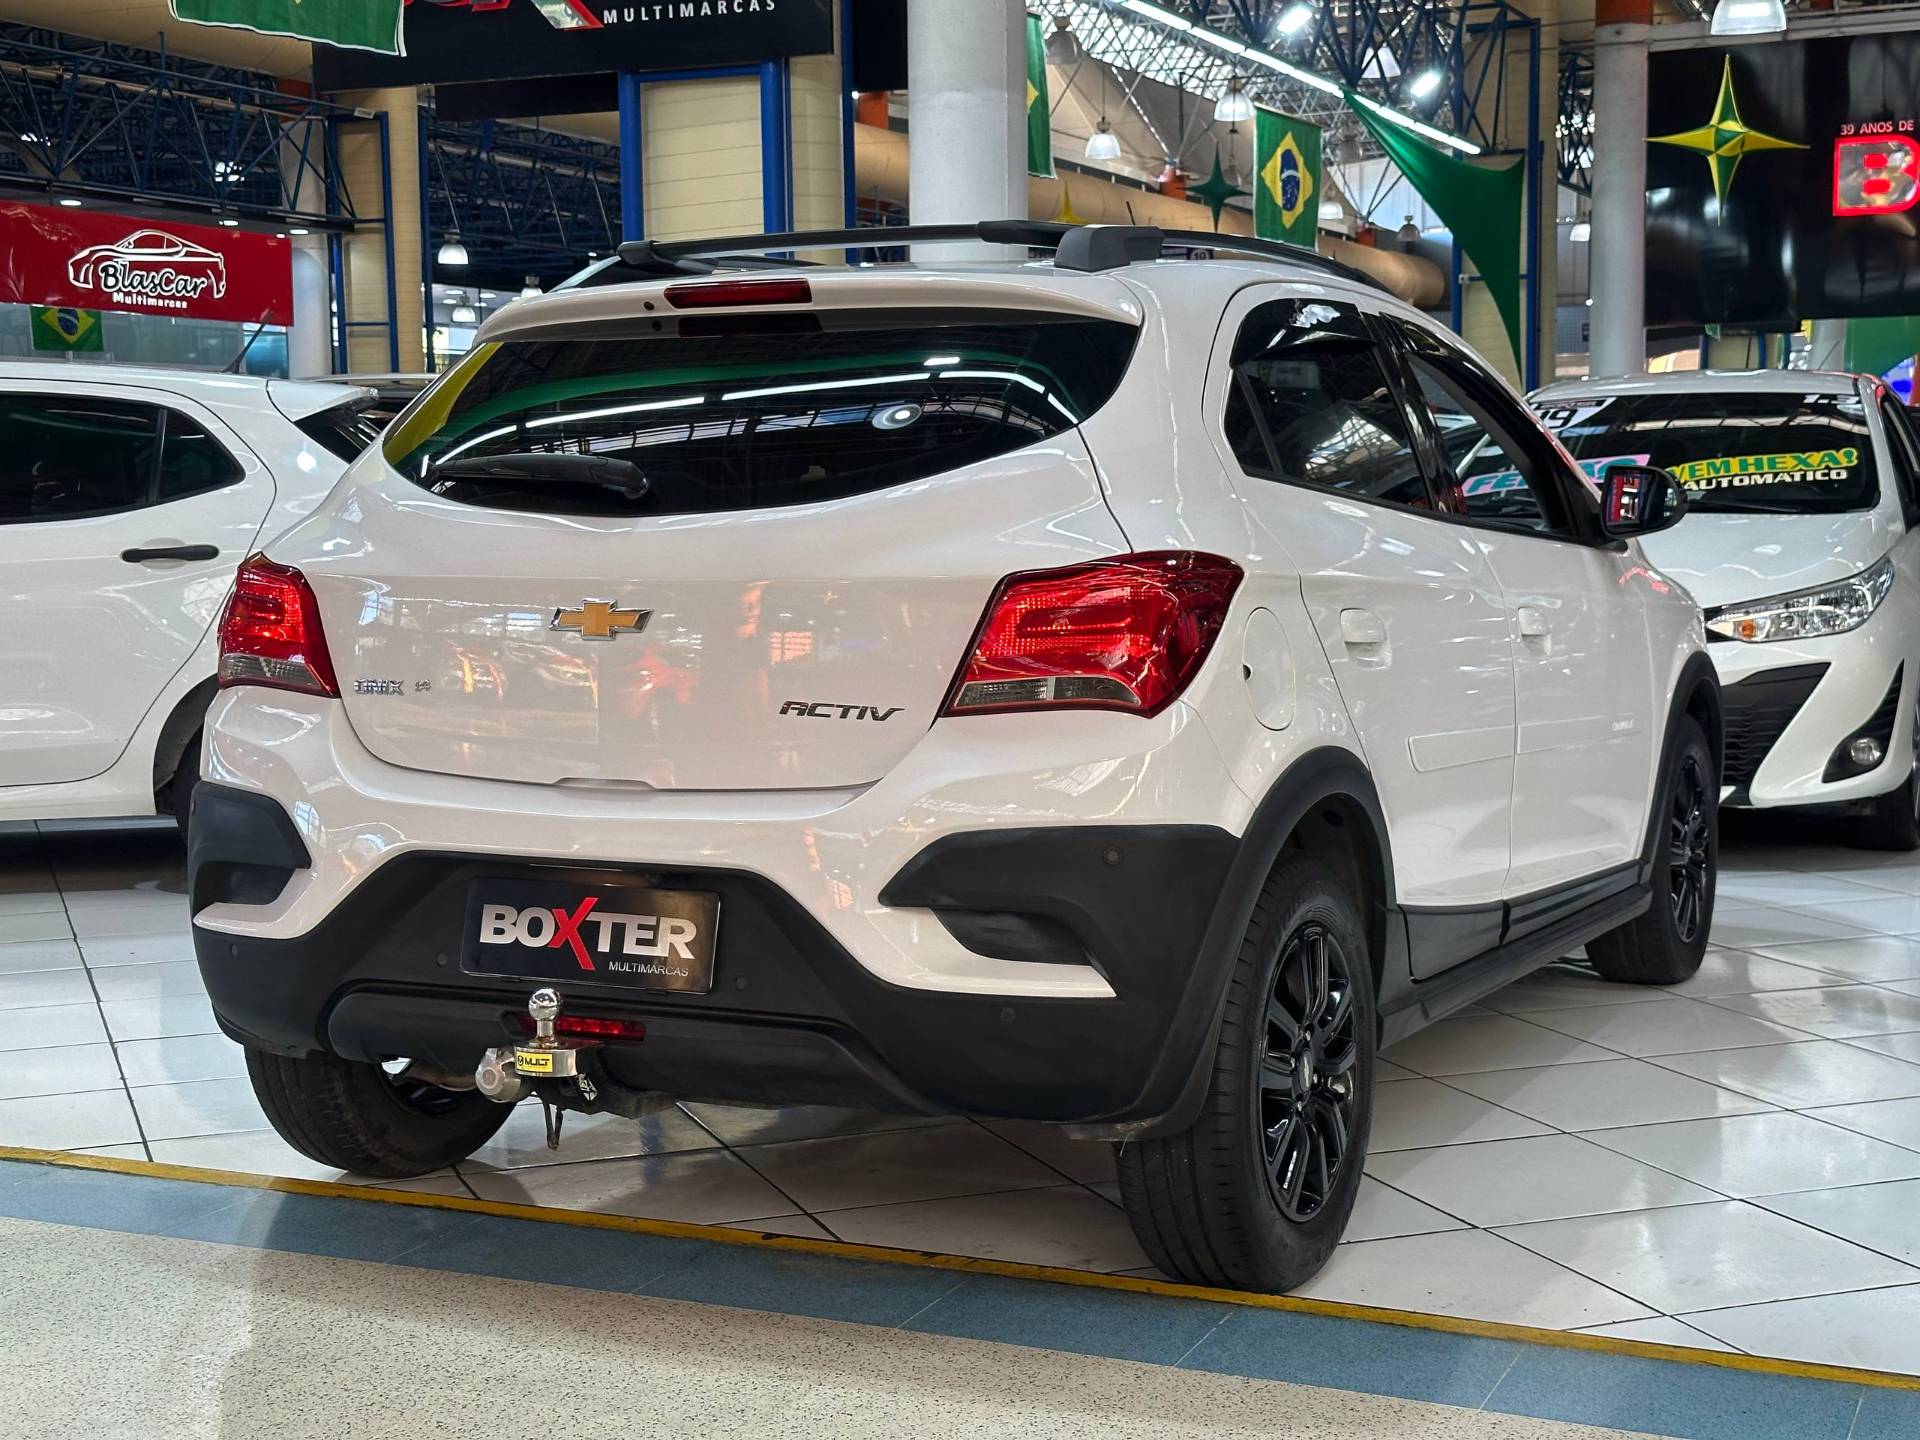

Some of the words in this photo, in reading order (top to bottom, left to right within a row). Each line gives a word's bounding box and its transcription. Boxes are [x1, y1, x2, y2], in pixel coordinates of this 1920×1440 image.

[603, 0, 775, 24] MULTIMARCAS
[1840, 124, 1854, 135] 39
[1860, 121, 1893, 134] ANOS
[1898, 119, 1914, 131] DE
[100, 260, 208, 298] BlasCar
[112, 291, 188, 309] Multimarcas
[1737, 447, 1858, 474] HEXA!
[779, 700, 905, 722] ACTIV
[479, 896, 698, 972] BOXTER
[608, 960, 689, 977] MULTIMARCAS
